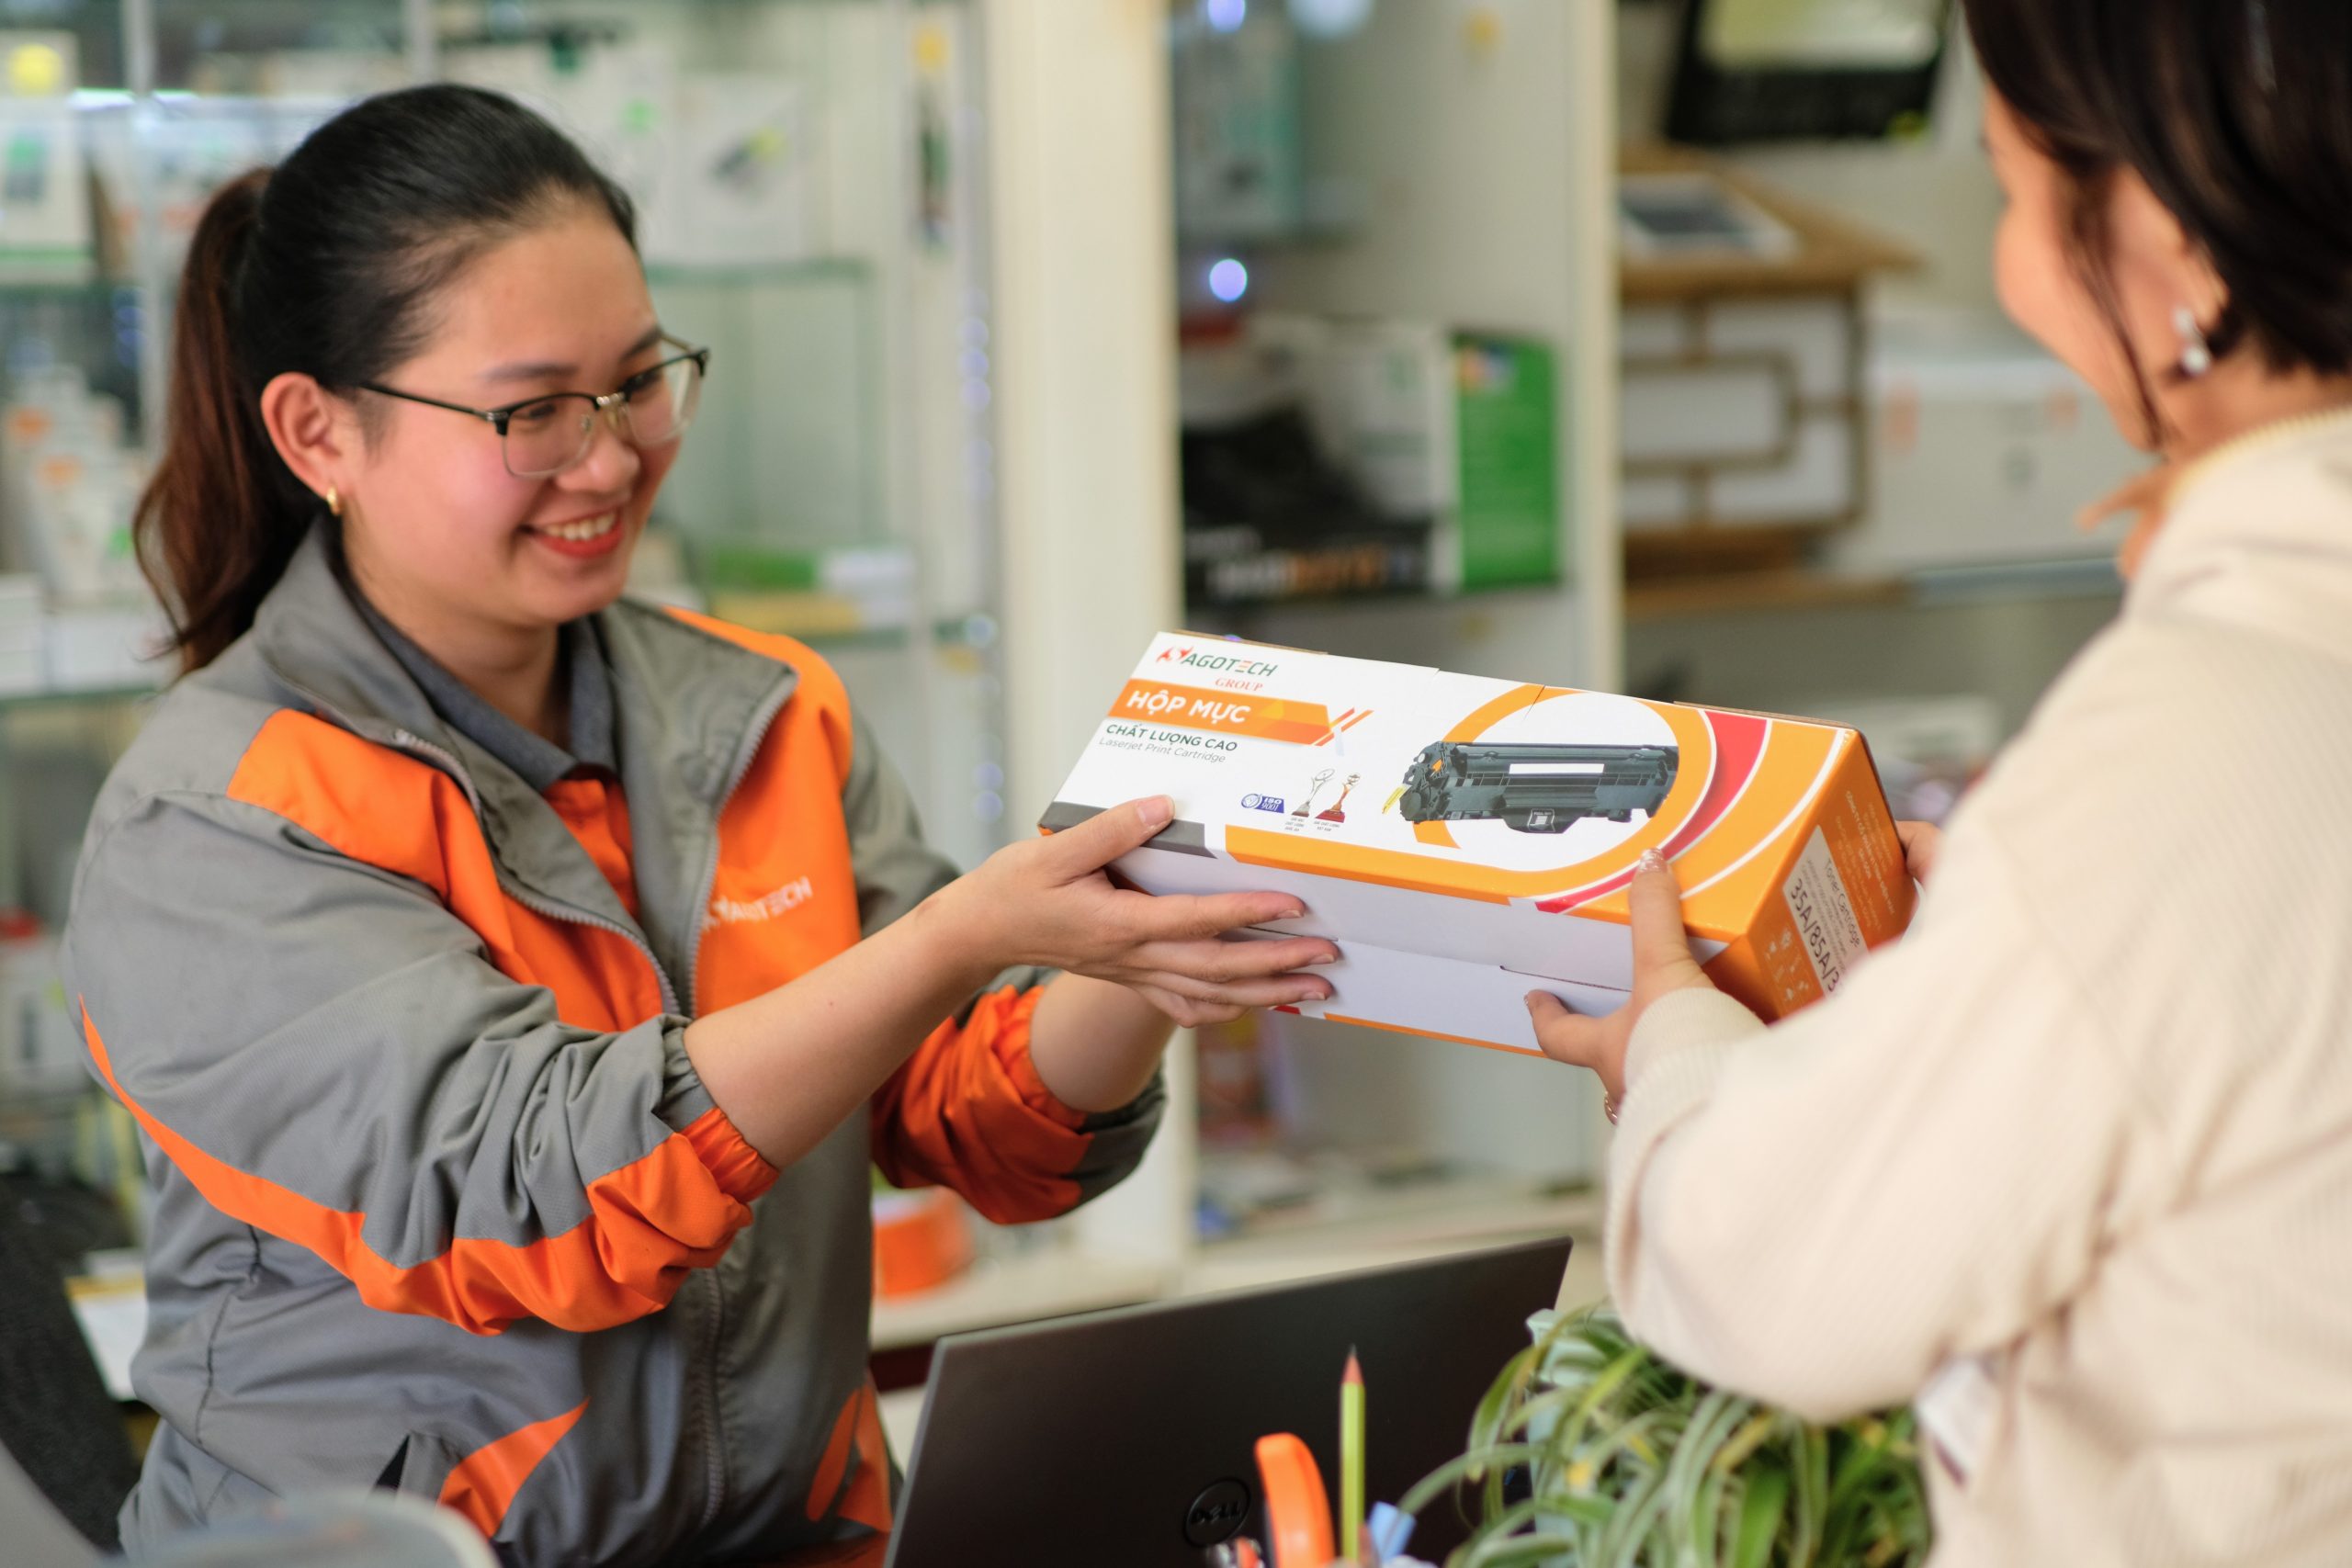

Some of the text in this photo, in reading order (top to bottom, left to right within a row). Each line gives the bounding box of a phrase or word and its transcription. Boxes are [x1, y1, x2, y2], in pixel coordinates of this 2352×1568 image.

[1215, 677, 1263, 692] GROUP
[1126, 690, 1251, 725] HỘP MỰC
[1106, 721, 1238, 751] CHẤT LƯỢNG CAO
[1099, 737, 1226, 763] Laserjet Print Cartridge
[1261, 802, 1280, 811] 9001
[1264, 796, 1283, 805] ISO
[1791, 877, 1841, 992] 35A/85A/3
